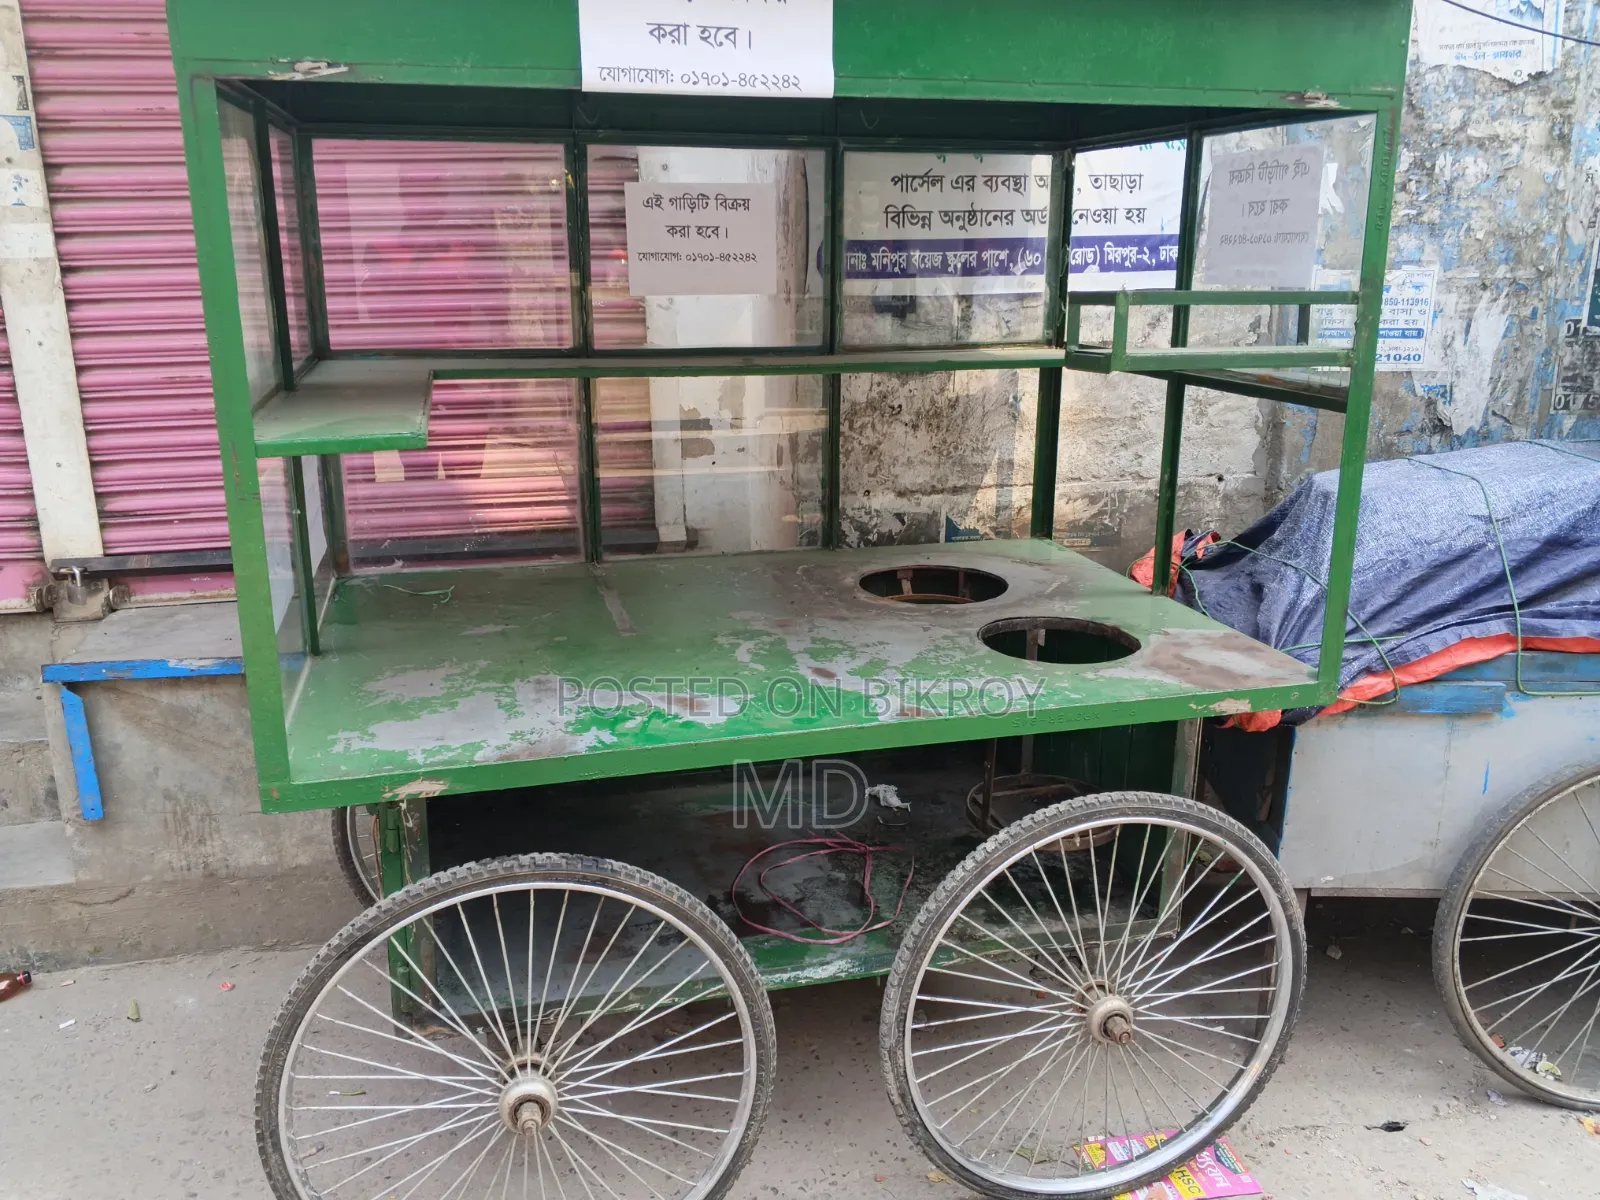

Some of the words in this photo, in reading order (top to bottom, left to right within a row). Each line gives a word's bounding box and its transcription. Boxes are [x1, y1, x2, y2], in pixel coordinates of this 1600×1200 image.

[646, 22, 690, 46] করা
[681, 71, 802, 92] ০১৭০১-৪৫২২৪২
[891, 168, 945, 194] পার্সেল
[950, 174, 977, 193] এর
[982, 173, 1029, 196] ব্যবস্থা
[1088, 173, 1144, 194] তাছাড়া
[642, 192, 664, 211] এই
[669, 192, 710, 213] গাড়িটি
[715, 193, 751, 212] বিক্রয়
[883, 203, 934, 231] বিভিন্ন
[939, 202, 1016, 233] অনুষ্ঠানের
[1072, 206, 1119, 225] নেওয়া
[1123, 207, 1147, 225] হয়
[665, 225, 691, 239] করা
[685, 253, 758, 263] ০১৭০১-৪৫২২৪২
[871, 246, 907, 275] মনিপুর
[910, 250, 944, 270] বয়েজ
[946, 250, 978, 274] স্কুলের
[1070, 245, 1100, 268] রোড)
[1104, 241, 1156, 269] মিরপুর-২,
[1159, 245, 1179, 263] ঢাক
[1382, 297, 1429, 307] 850-113916
[1375, 353, 1422, 362] 21040
[1175, 1169, 1202, 1194] HSC
